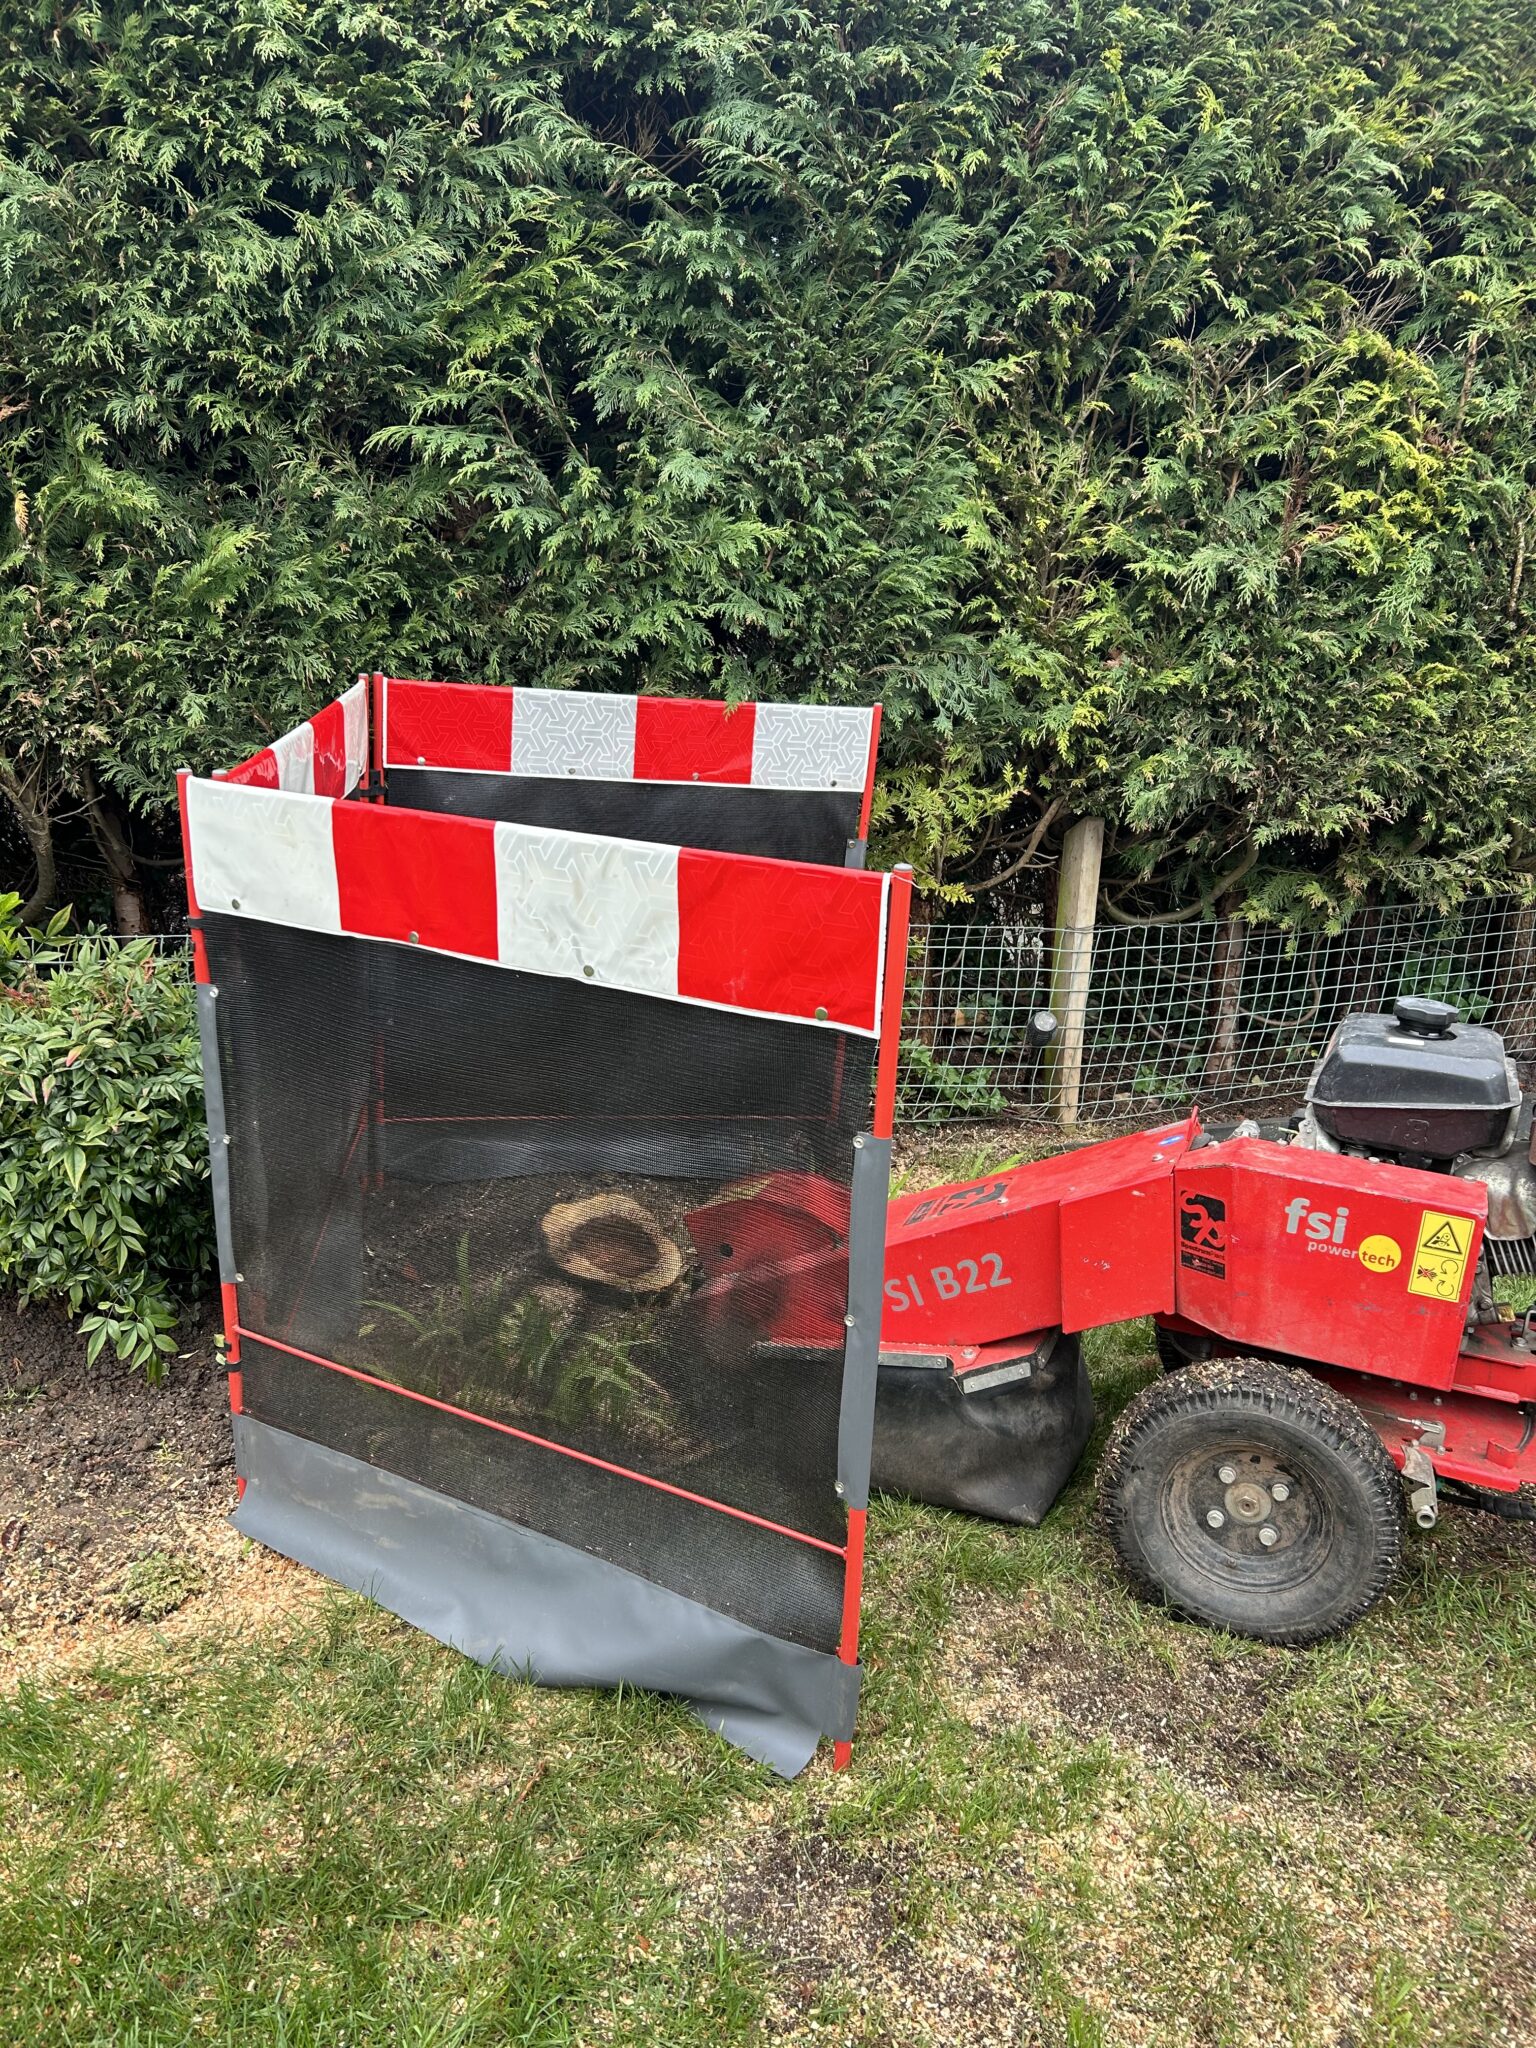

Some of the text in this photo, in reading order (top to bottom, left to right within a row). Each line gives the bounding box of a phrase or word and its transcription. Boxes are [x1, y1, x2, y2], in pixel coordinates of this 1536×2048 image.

[1284, 1197, 1349, 1244] fsi
[1307, 1241, 1396, 1268] power tech
[884, 1252, 1012, 1312] SI B22
